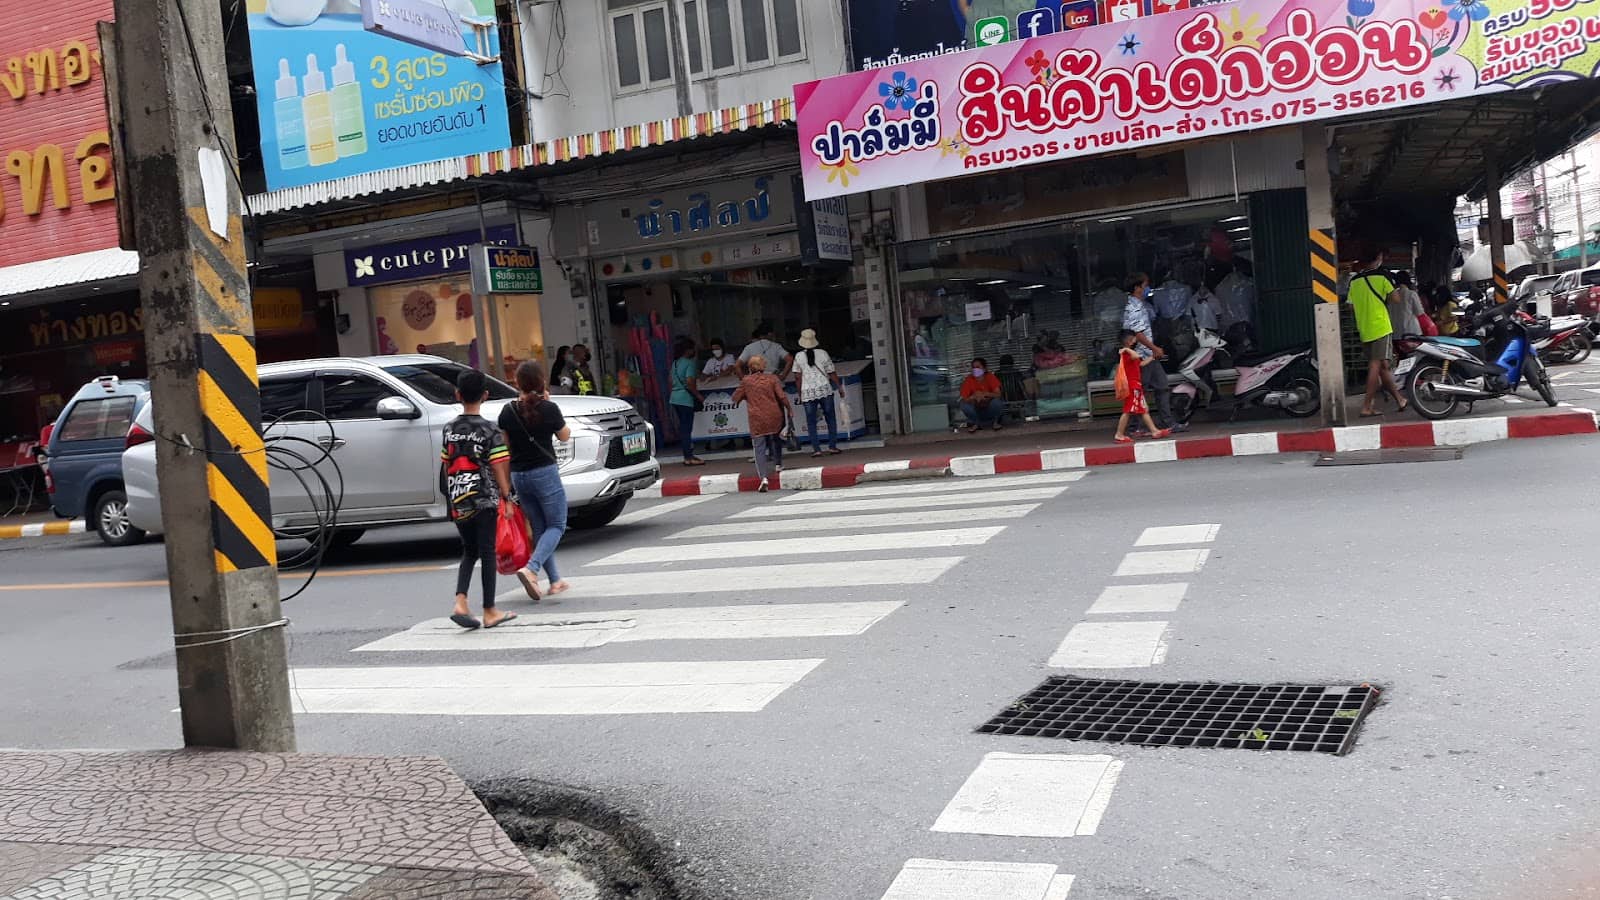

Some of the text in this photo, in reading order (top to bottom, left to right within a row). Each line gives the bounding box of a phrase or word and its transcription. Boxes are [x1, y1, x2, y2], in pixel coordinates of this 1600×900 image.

[983, 29, 1001, 38] LINE
[1484, 9, 1524, 33] ครบ
[1486, 18, 1578, 62] รับของ
[370, 53, 449, 91] 3 สูตร
[961, 11, 1425, 140] สินค้าเด็กอ่อน
[1480, 38, 1582, 81] สมนาคุณ
[375, 80, 486, 119] เซรั่มซ่อมผิว
[378, 111, 475, 143] ยอดขายอันดับ
[813, 83, 939, 162] ปาล์มมี่
[963, 81, 1426, 169] ครบวงจร ขายปลีก-ส่ง โทร.075-356216
[634, 175, 774, 239] นำศิลป์
